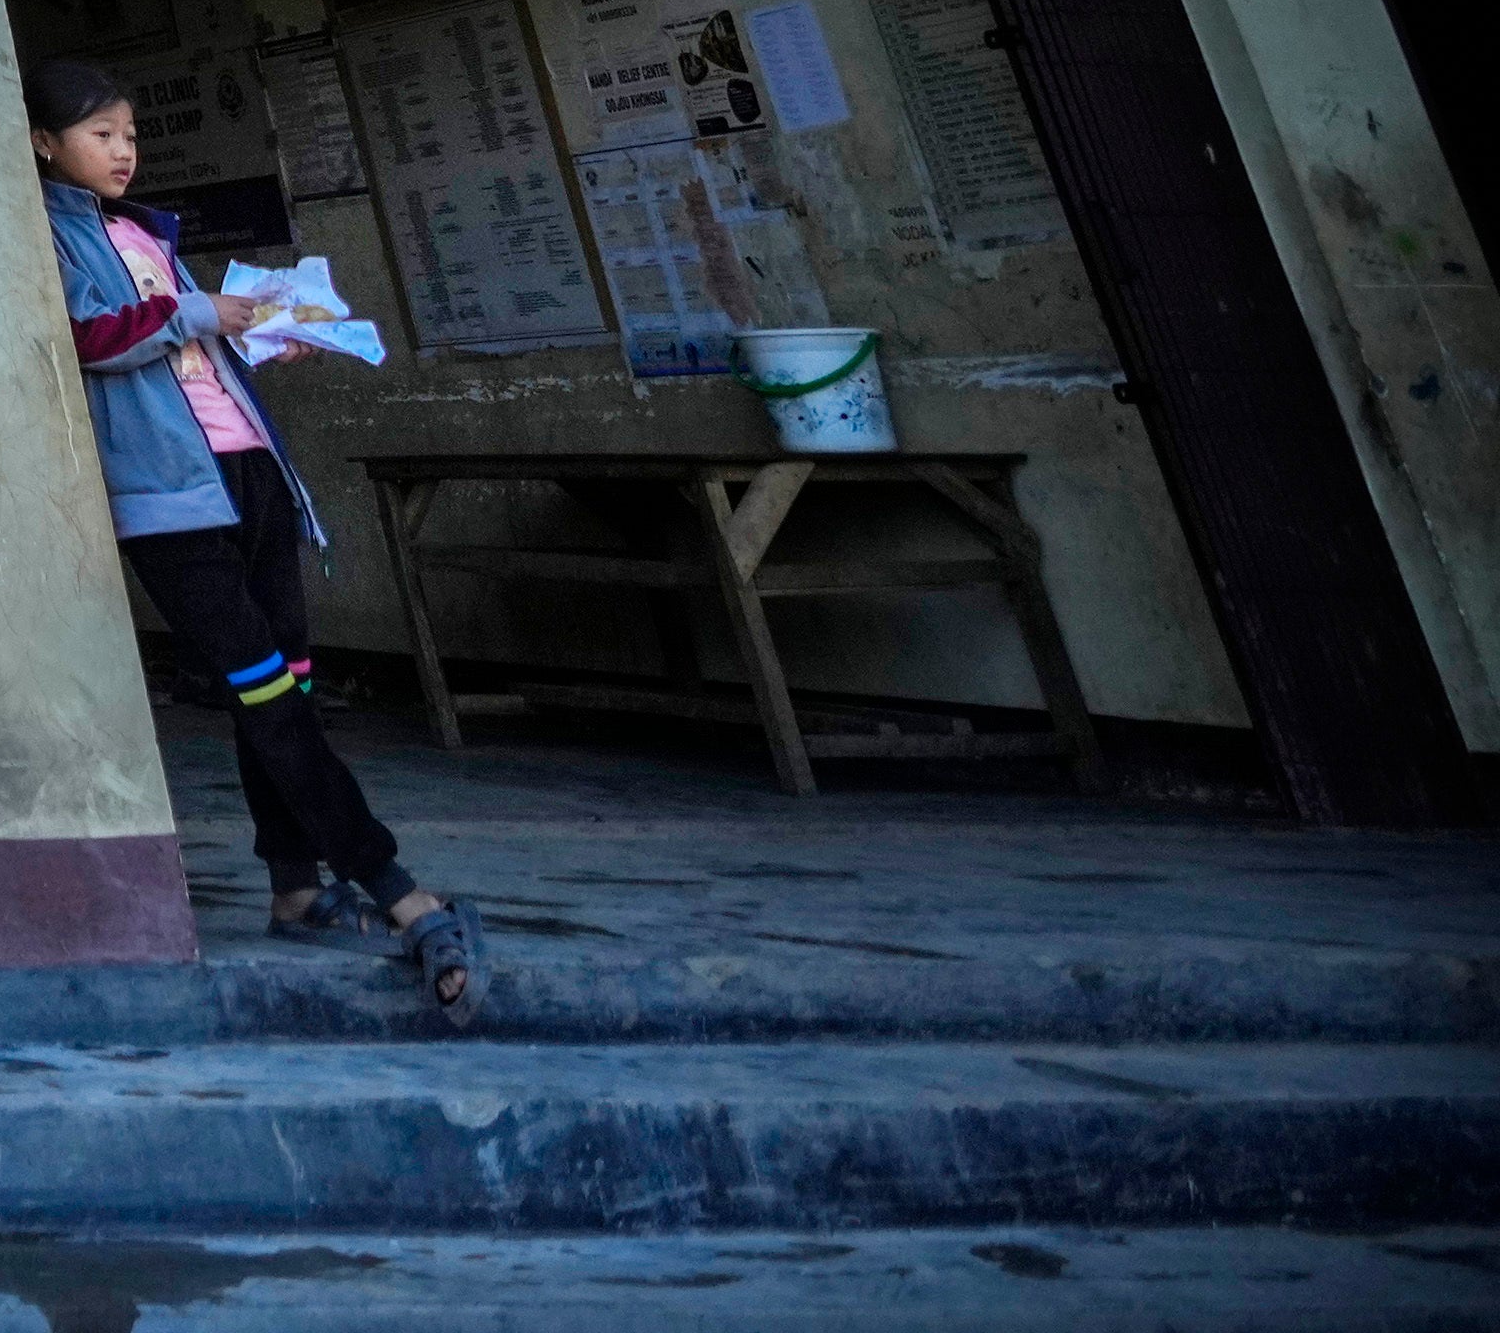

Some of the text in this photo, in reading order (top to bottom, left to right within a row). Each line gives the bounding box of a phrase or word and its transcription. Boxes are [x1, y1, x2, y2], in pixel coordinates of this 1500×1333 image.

[617, 67, 641, 85] RELIEF
[641, 61, 671, 81] CENTRE
[153, 75, 200, 106] CLINIC
[165, 108, 203, 135] CAMP
